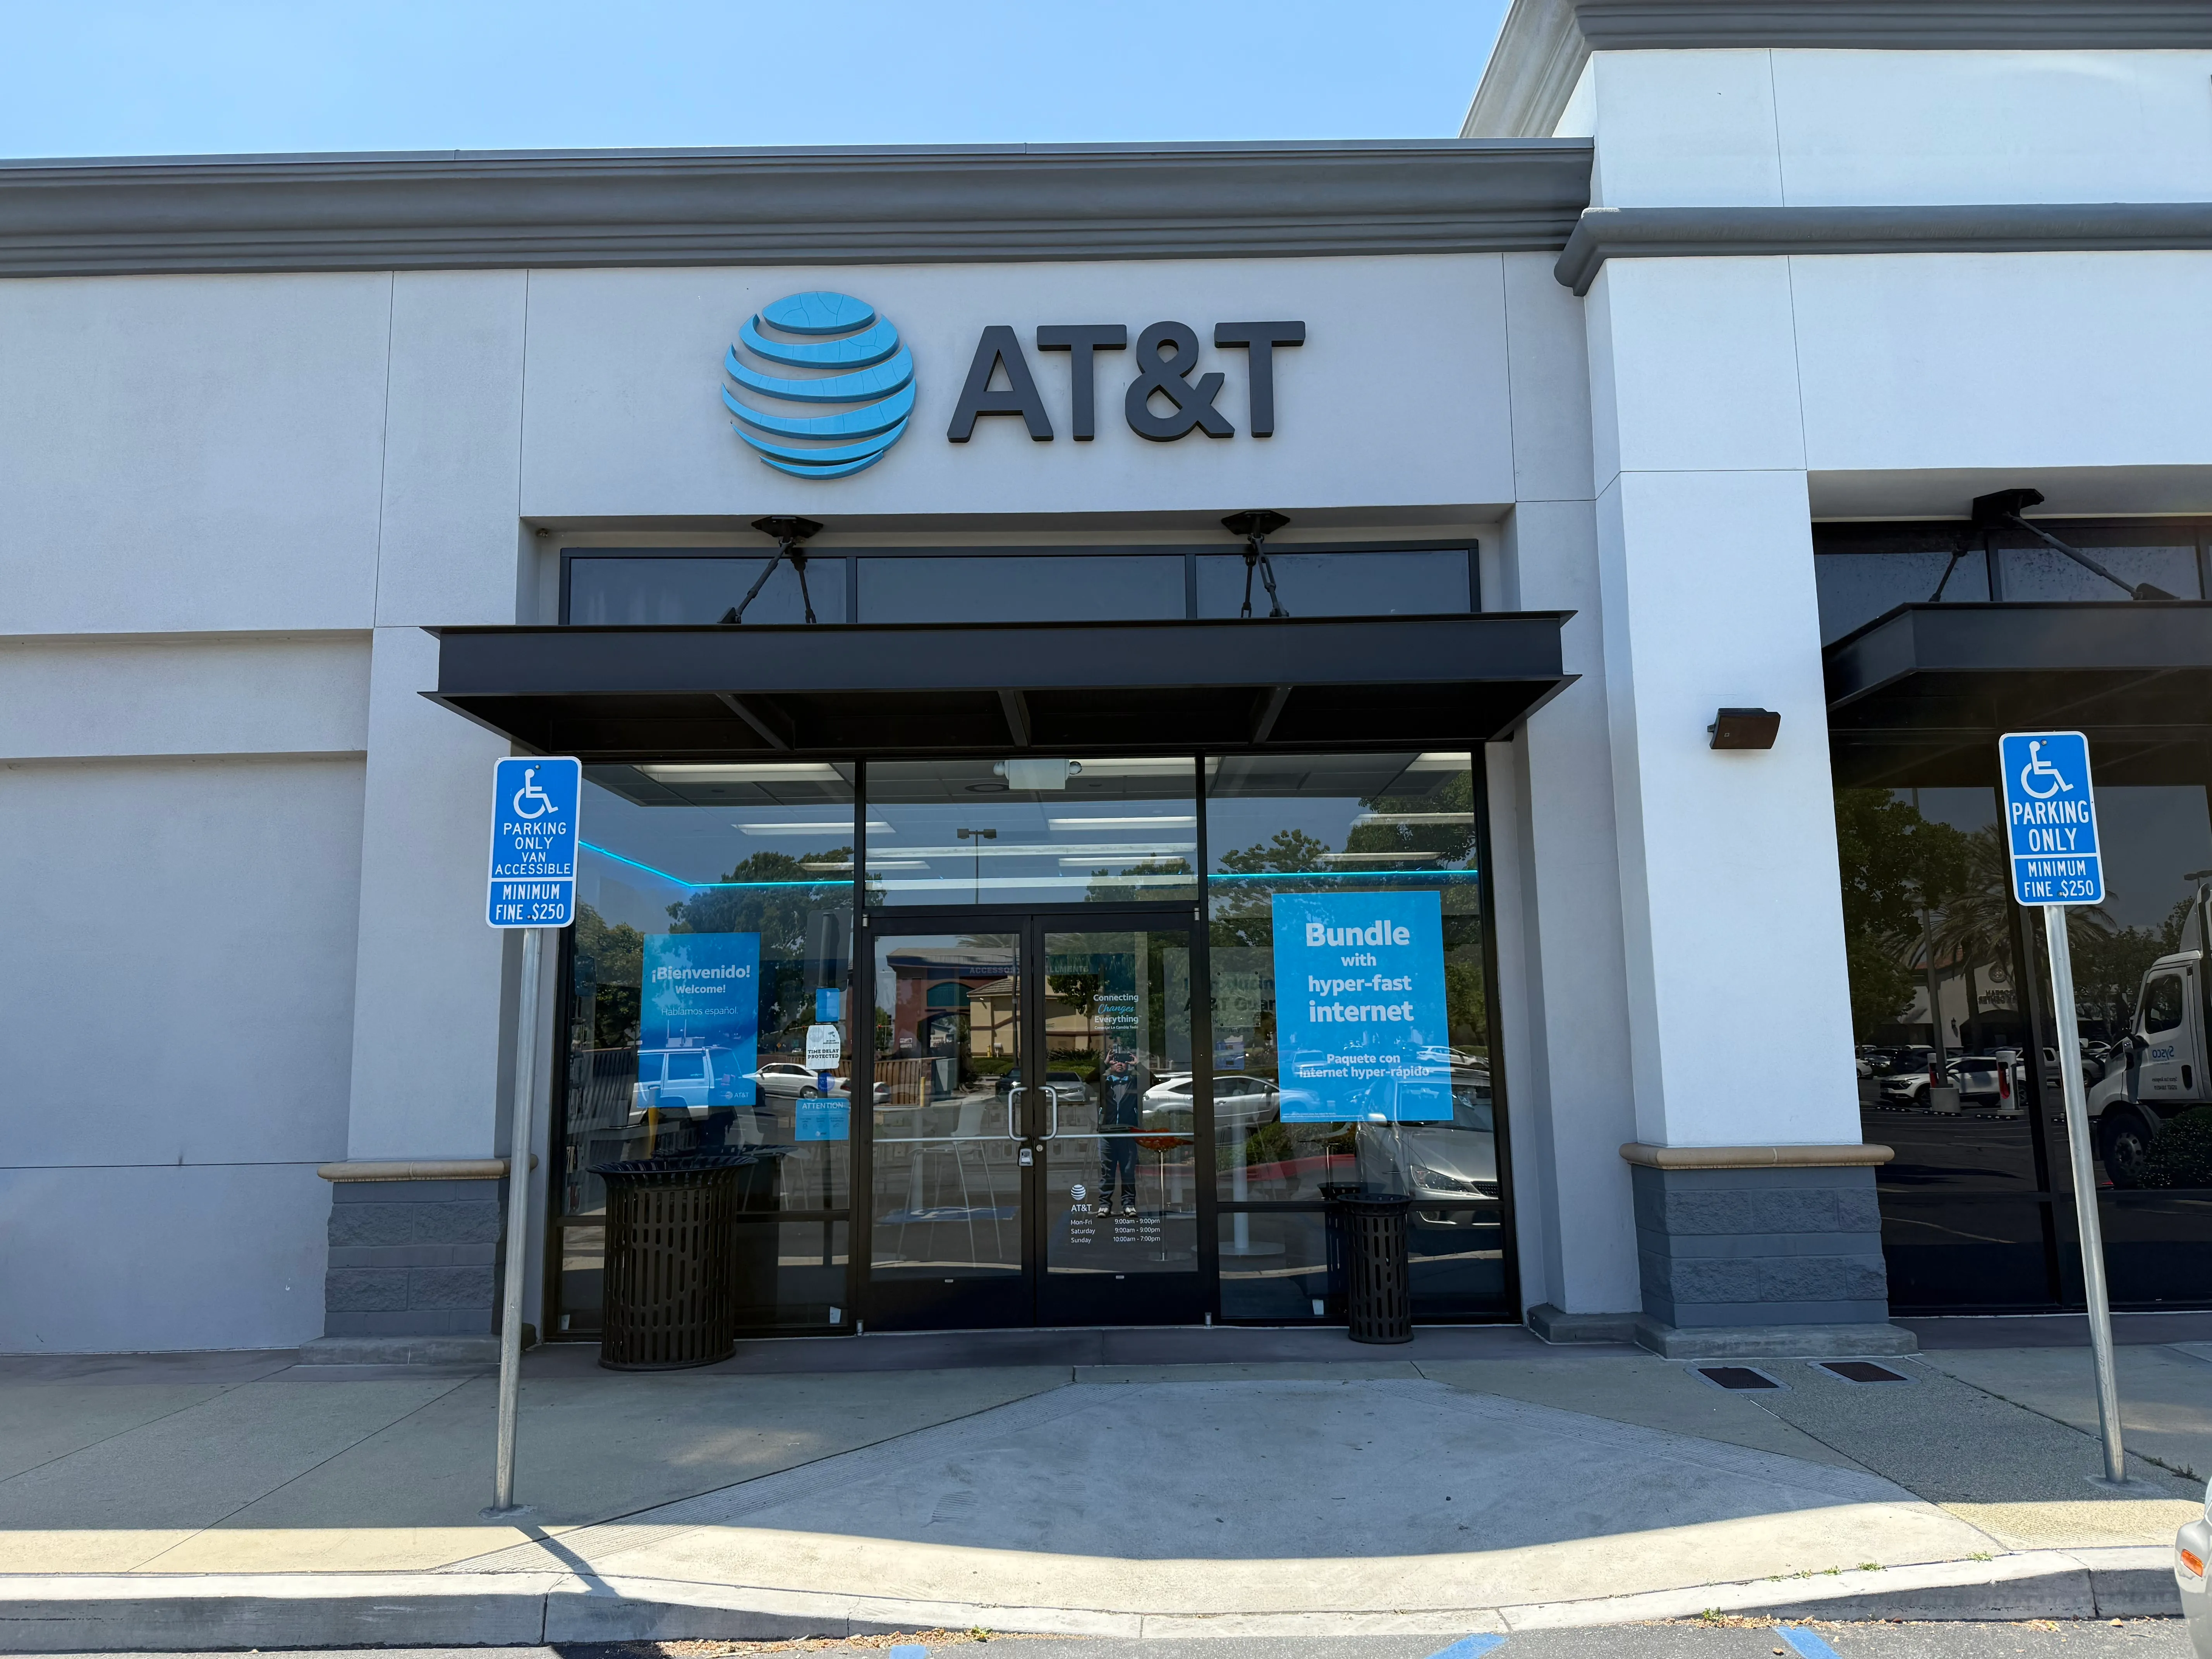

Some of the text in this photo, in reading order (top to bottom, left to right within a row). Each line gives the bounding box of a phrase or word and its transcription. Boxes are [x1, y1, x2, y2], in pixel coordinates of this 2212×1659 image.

[946, 320, 1306, 443] AT&T
[2012, 800, 2089, 825] PARKING
[503, 822, 566, 835] PARKING
[515, 836, 553, 850] ONLY
[2028, 828, 2076, 852] ONLY
[522, 852, 546, 863] VAN
[495, 863, 571, 875] ACCESSIBLE
[2028, 860, 2086, 877] MINIMUM
[503, 884, 560, 900] MINIMUM
[2024, 879, 2094, 898] FINE $250
[496, 903, 565, 921] FINE $250
[1305, 920, 1410, 947] Bundle
[1341, 953, 1376, 967] with
[652, 965, 750, 983] ¡Bienvenido!
[675, 984, 726, 994] Welcome!
[1308, 974, 1412, 997] hyper-fast
[1093, 993, 1139, 1002] Connecting
[661, 1006, 738, 1017] Hablamos español.
[1098, 1003, 1135, 1014] Changes
[1309, 1000, 1414, 1022] internet
[1094, 1015, 1139, 1024] Everything
[1327, 1053, 1400, 1066] Paquete con
[1299, 1066, 1430, 1080] internet hyper-rápido
[1071, 1204, 1092, 1212] AT&T
